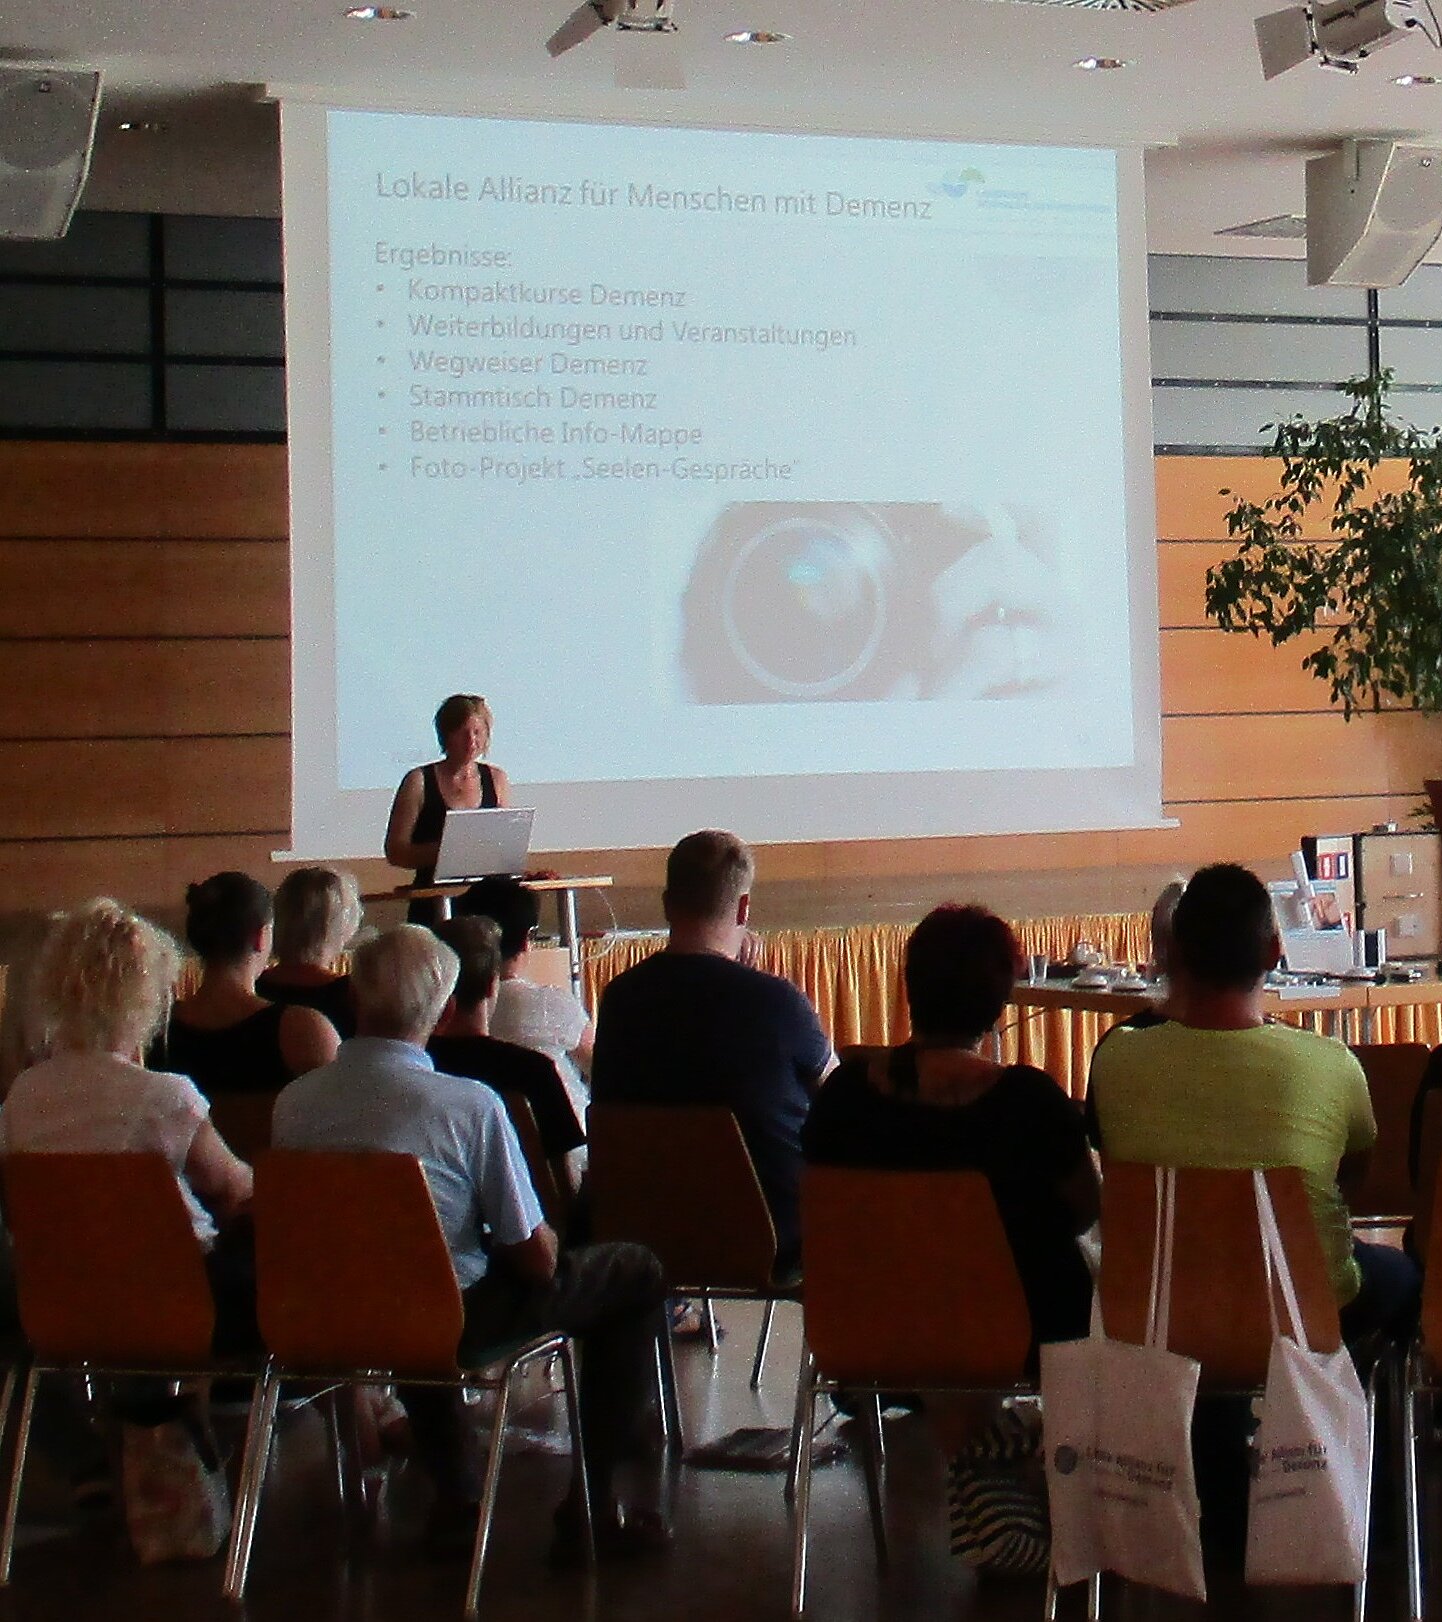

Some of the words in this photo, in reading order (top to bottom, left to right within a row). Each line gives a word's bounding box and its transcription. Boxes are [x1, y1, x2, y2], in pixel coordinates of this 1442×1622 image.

[377, 171, 470, 200] Lokale
[478, 176, 572, 205] Allianz
[579, 179, 619, 207] für
[628, 182, 766, 213] Menschen
[775, 189, 817, 215] mit
[826, 190, 932, 220] Demenz
[375, 241, 512, 271] Ergebnisse:
[408, 278, 582, 306] Kompaktkurse
[591, 283, 687, 308] Demenz
[408, 314, 611, 345] Weiterbildungen
[619, 320, 663, 342] und
[672, 321, 857, 351] Veranstaltungen
[409, 351, 543, 378] Wegweiser
[551, 352, 648, 376] Demenz
[409, 384, 551, 409] Stammtisch
[560, 386, 657, 410] Demenz
[410, 418, 555, 443] Betriebliche
[562, 420, 703, 450] Info-Mappe
[411, 455, 566, 485] Foto-Projekt
